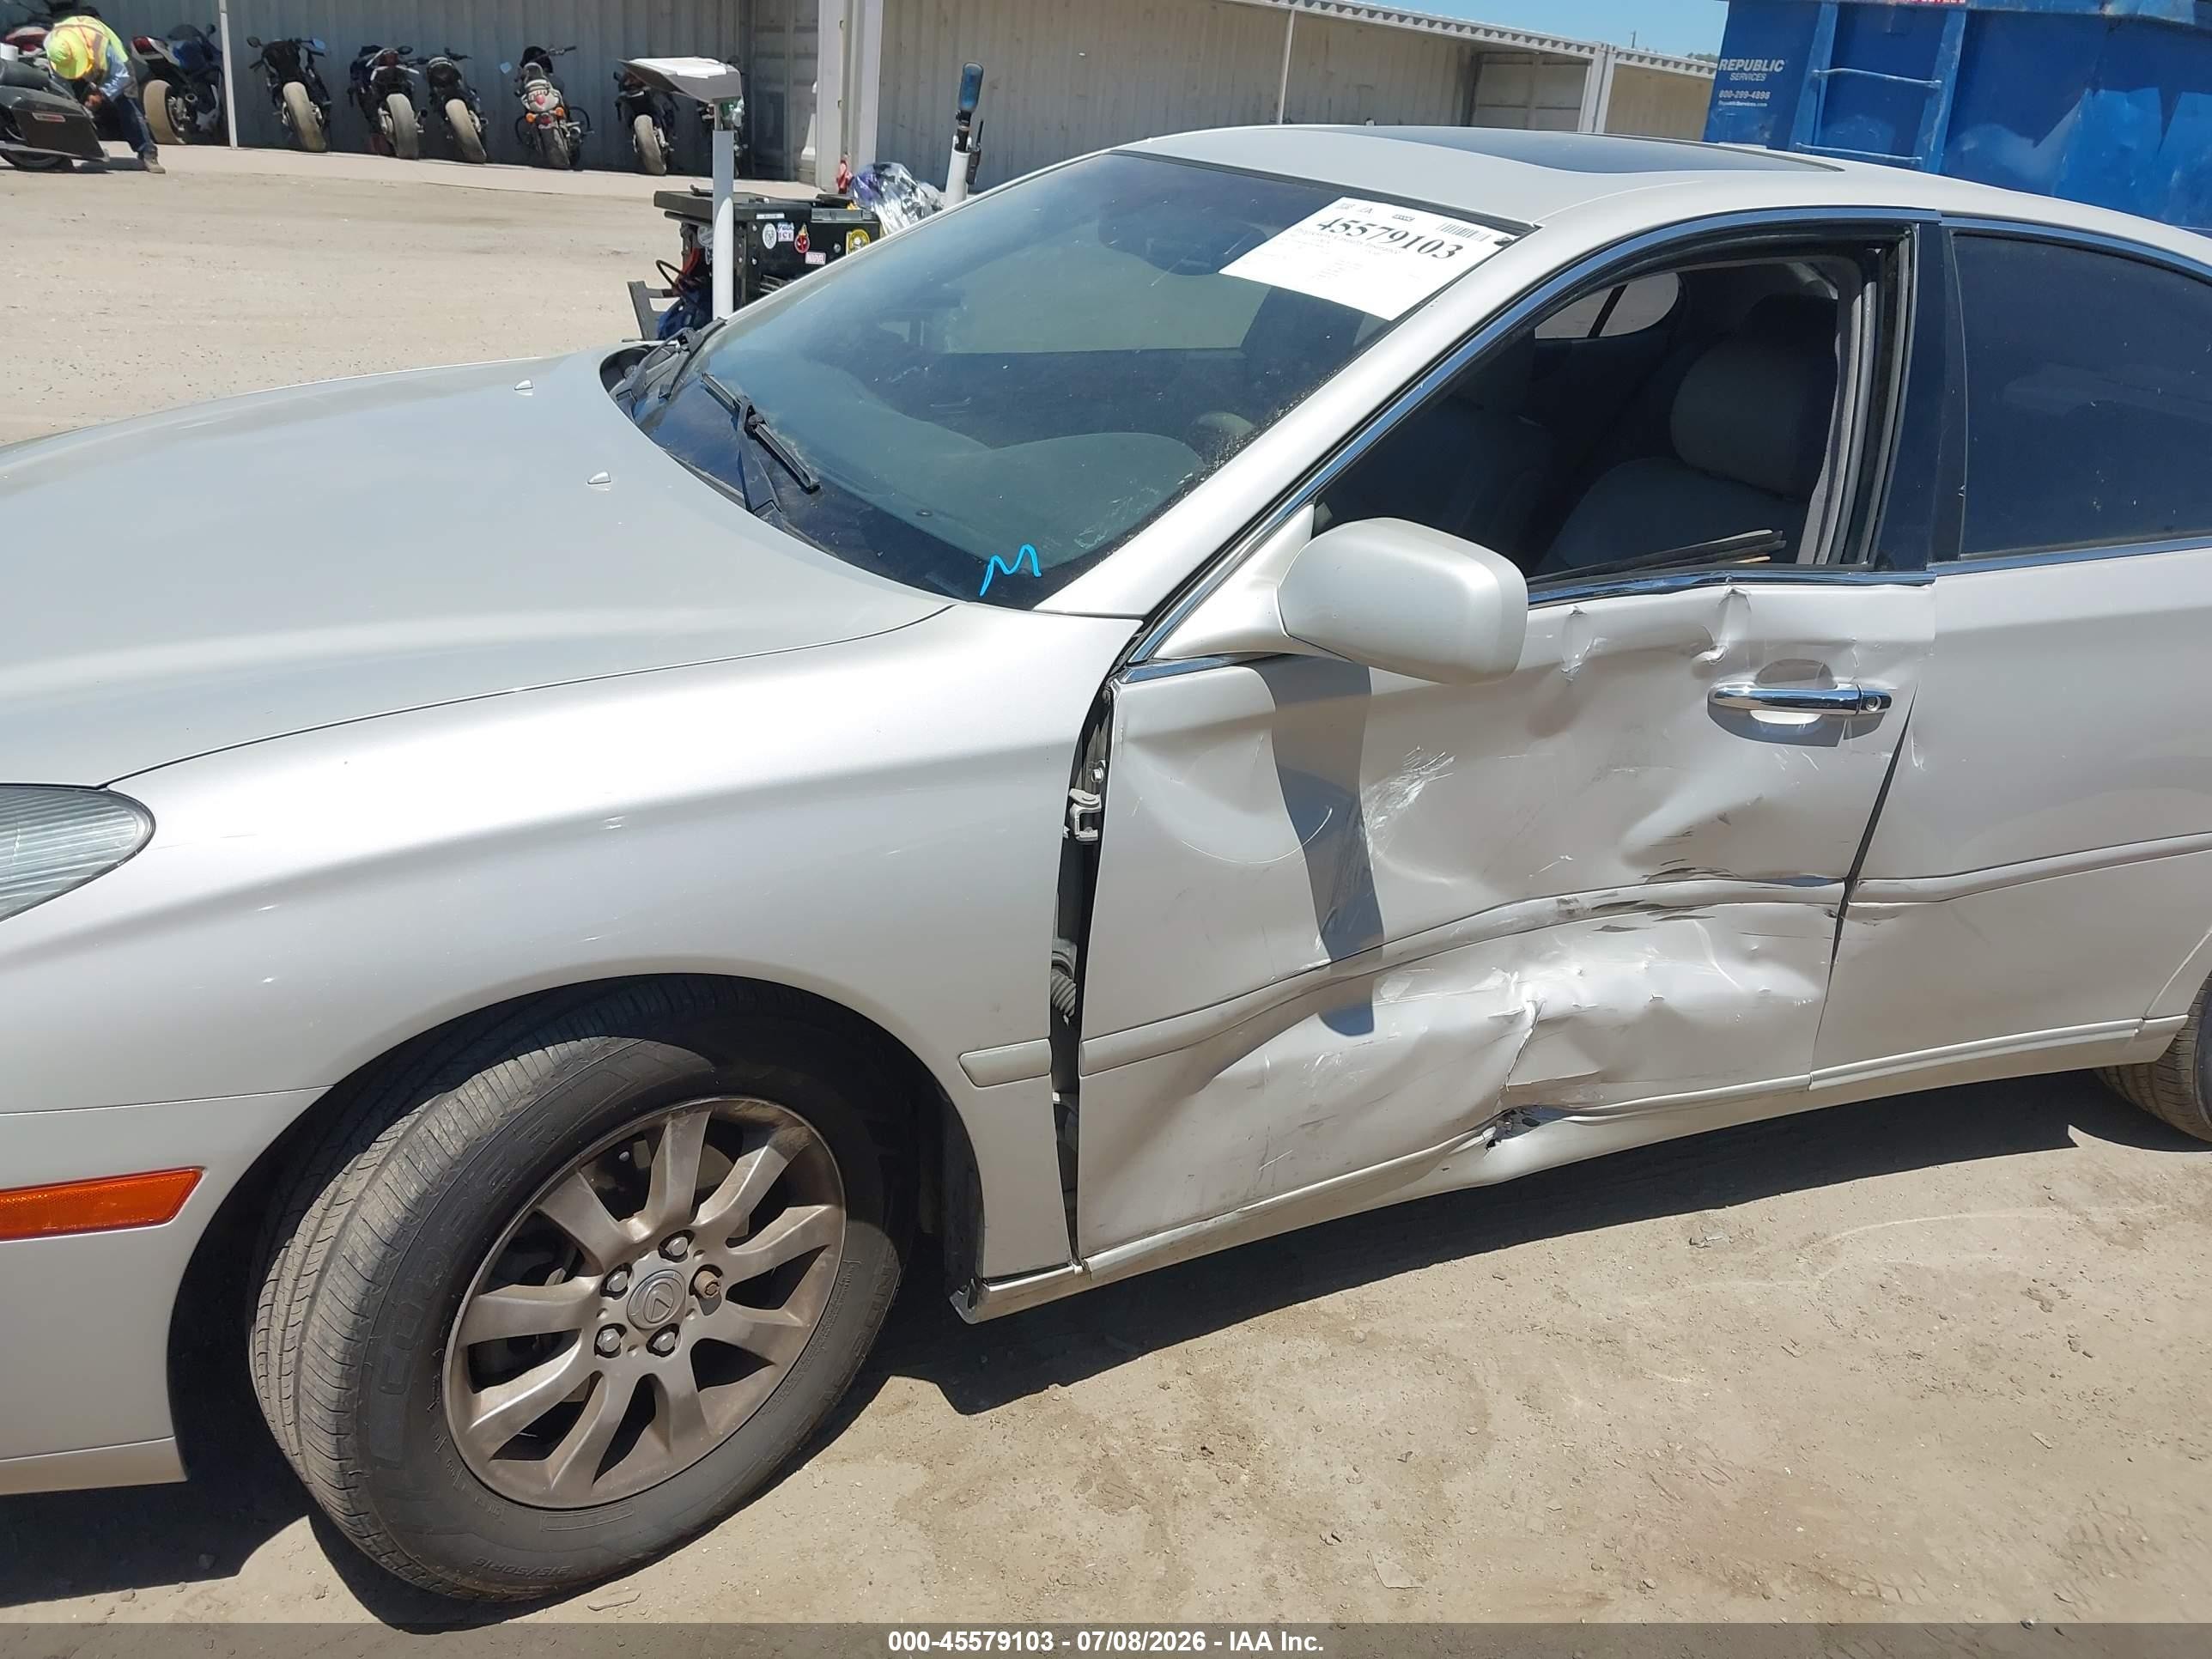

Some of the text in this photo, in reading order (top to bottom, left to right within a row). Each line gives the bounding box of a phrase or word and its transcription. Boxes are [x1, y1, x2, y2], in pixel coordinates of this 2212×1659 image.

[1718, 58, 1785, 72] REPUBLIC
[1729, 72, 1767, 82] SERVICES
[1316, 216, 1464, 258] 45579103
[980, 544, 1042, 596] M
